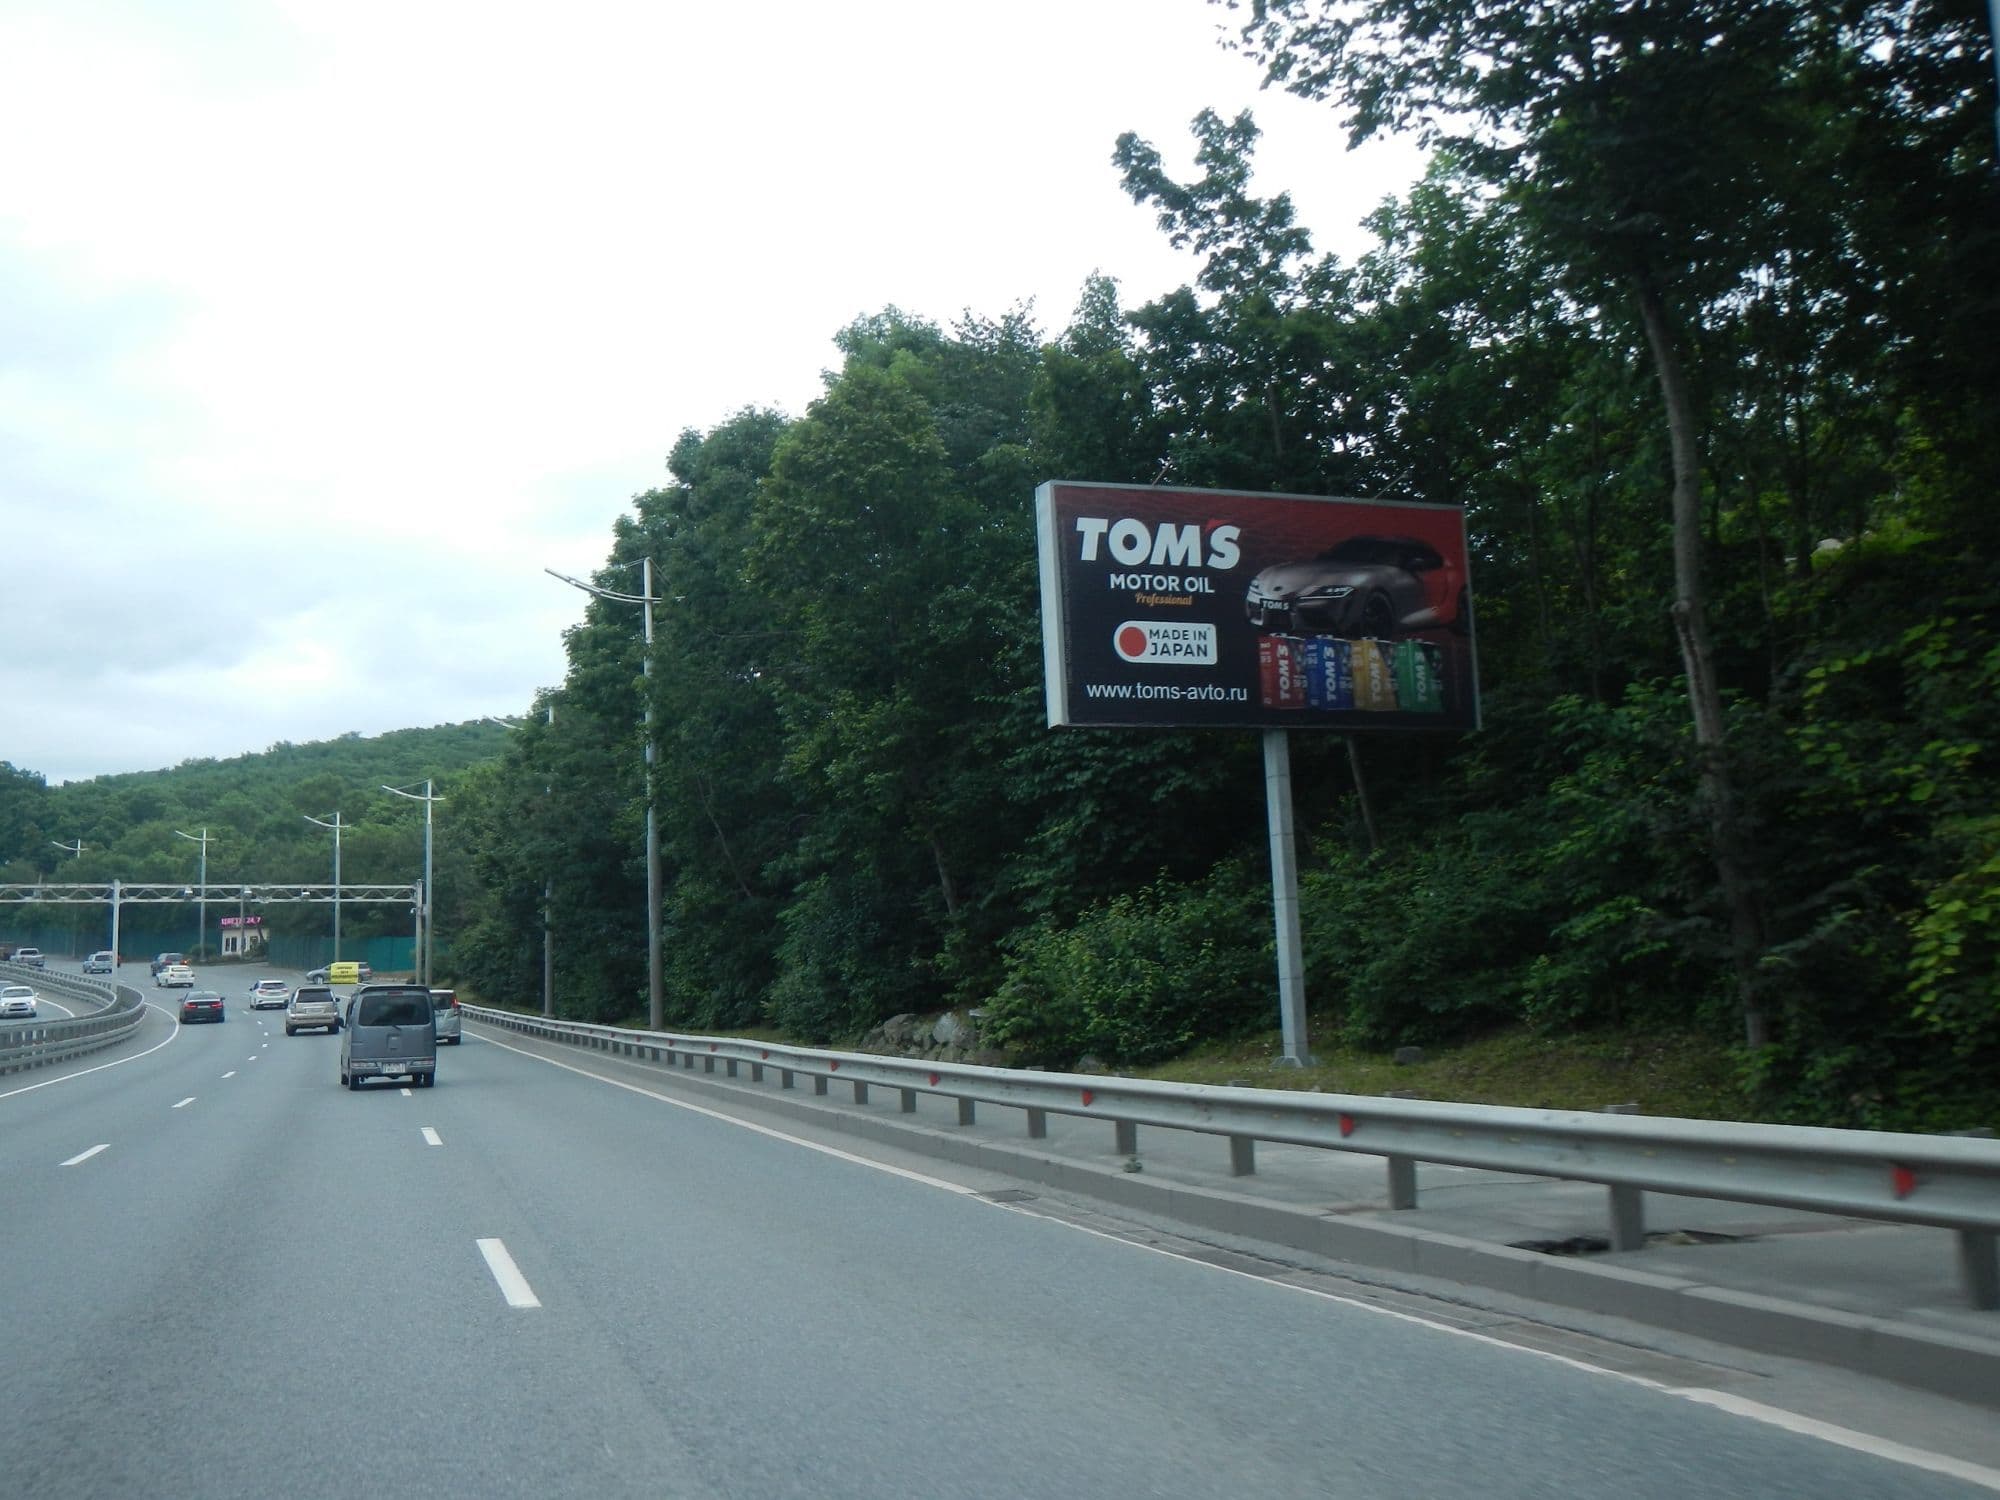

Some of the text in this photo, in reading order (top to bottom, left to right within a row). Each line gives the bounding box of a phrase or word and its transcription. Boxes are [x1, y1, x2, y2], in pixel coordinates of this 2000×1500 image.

[1110, 573, 1215, 593] MOTOR OIL
[1135, 592, 1192, 606] Professional
[1149, 629, 1208, 641] MADE IN
[1150, 643, 1208, 657] JAPAN
[1086, 682, 1248, 701] www.toms-avto.ru
